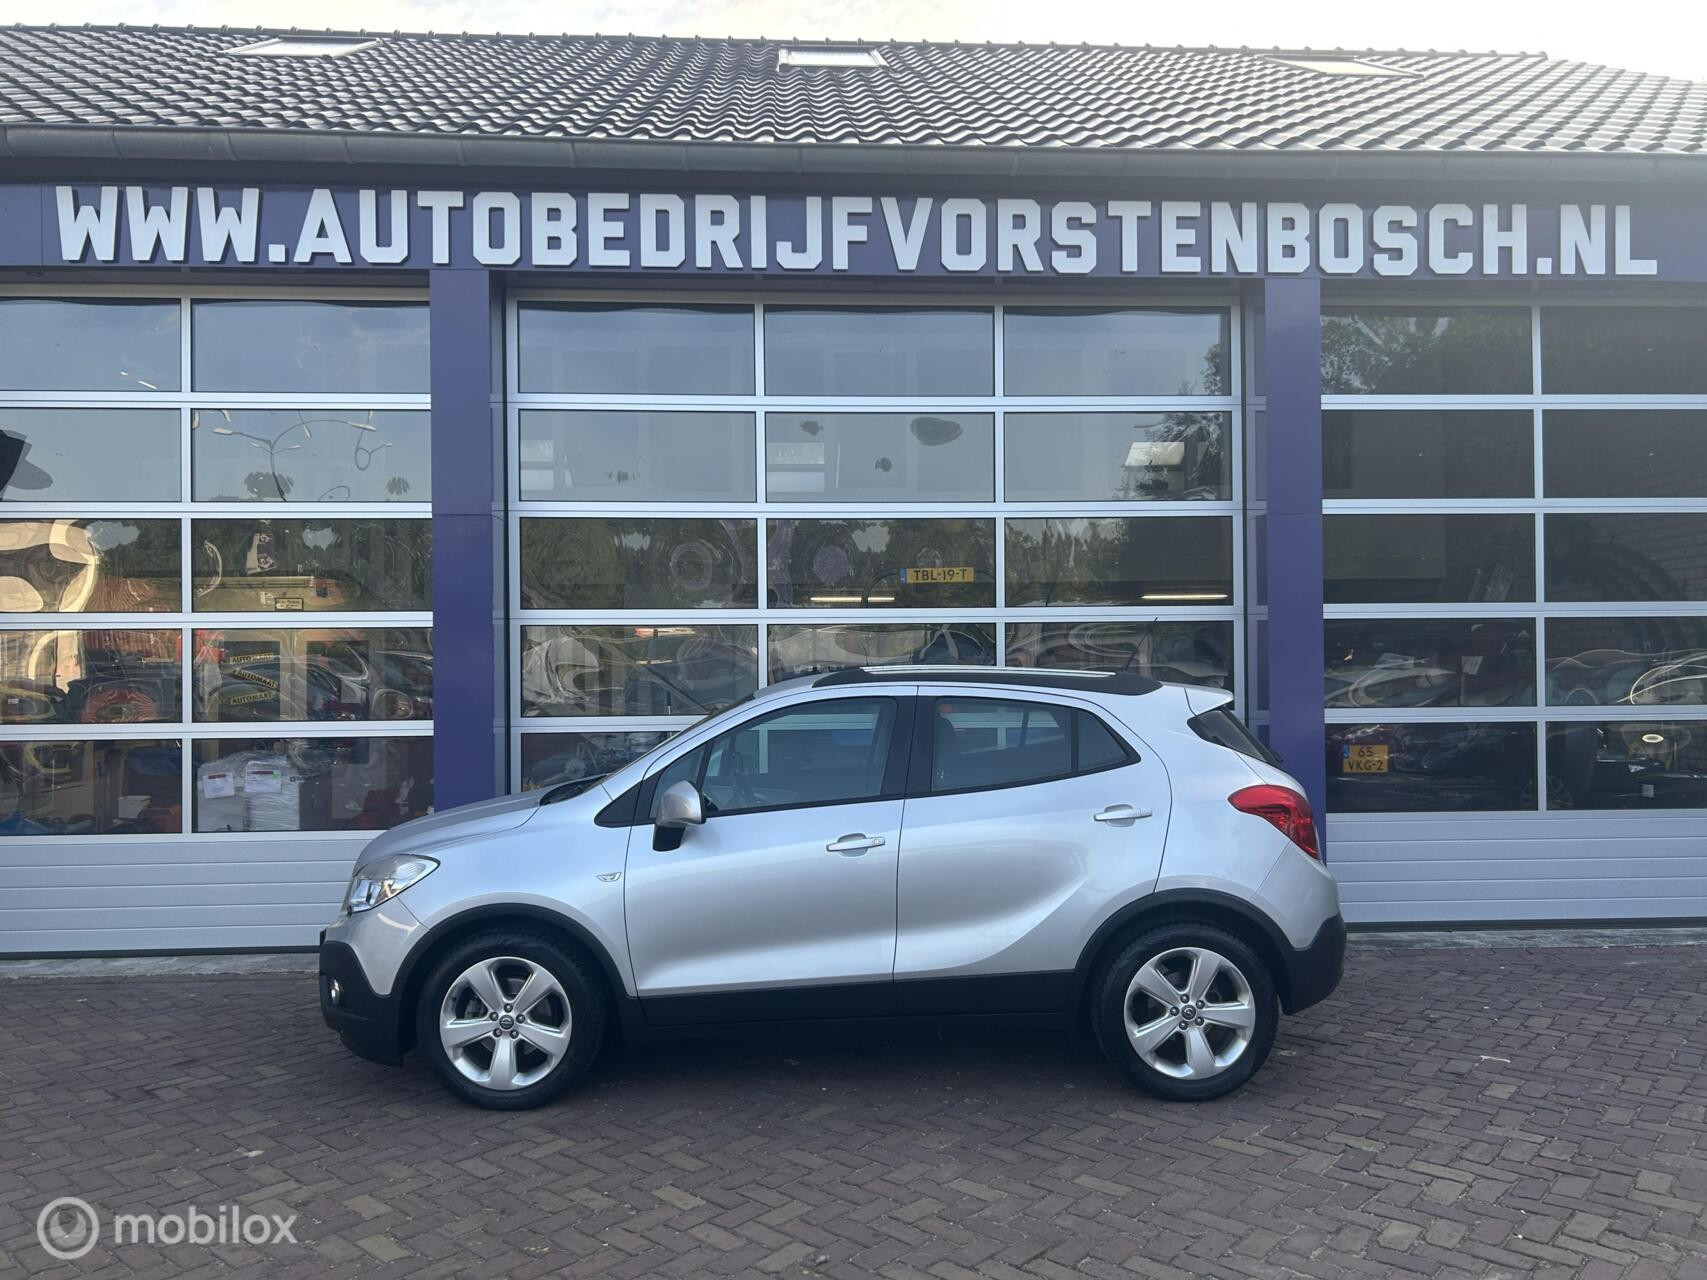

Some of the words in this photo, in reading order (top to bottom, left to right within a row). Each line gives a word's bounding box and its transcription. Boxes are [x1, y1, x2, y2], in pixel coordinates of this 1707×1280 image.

[56, 186, 1658, 276] WWW.AUTOBEDRIJFVORSTENBOSCH.NL
[913, 569, 967, 581] TBL-19-T
[1358, 747, 1374, 757] 65
[1348, 759, 1384, 771] VKG-2
